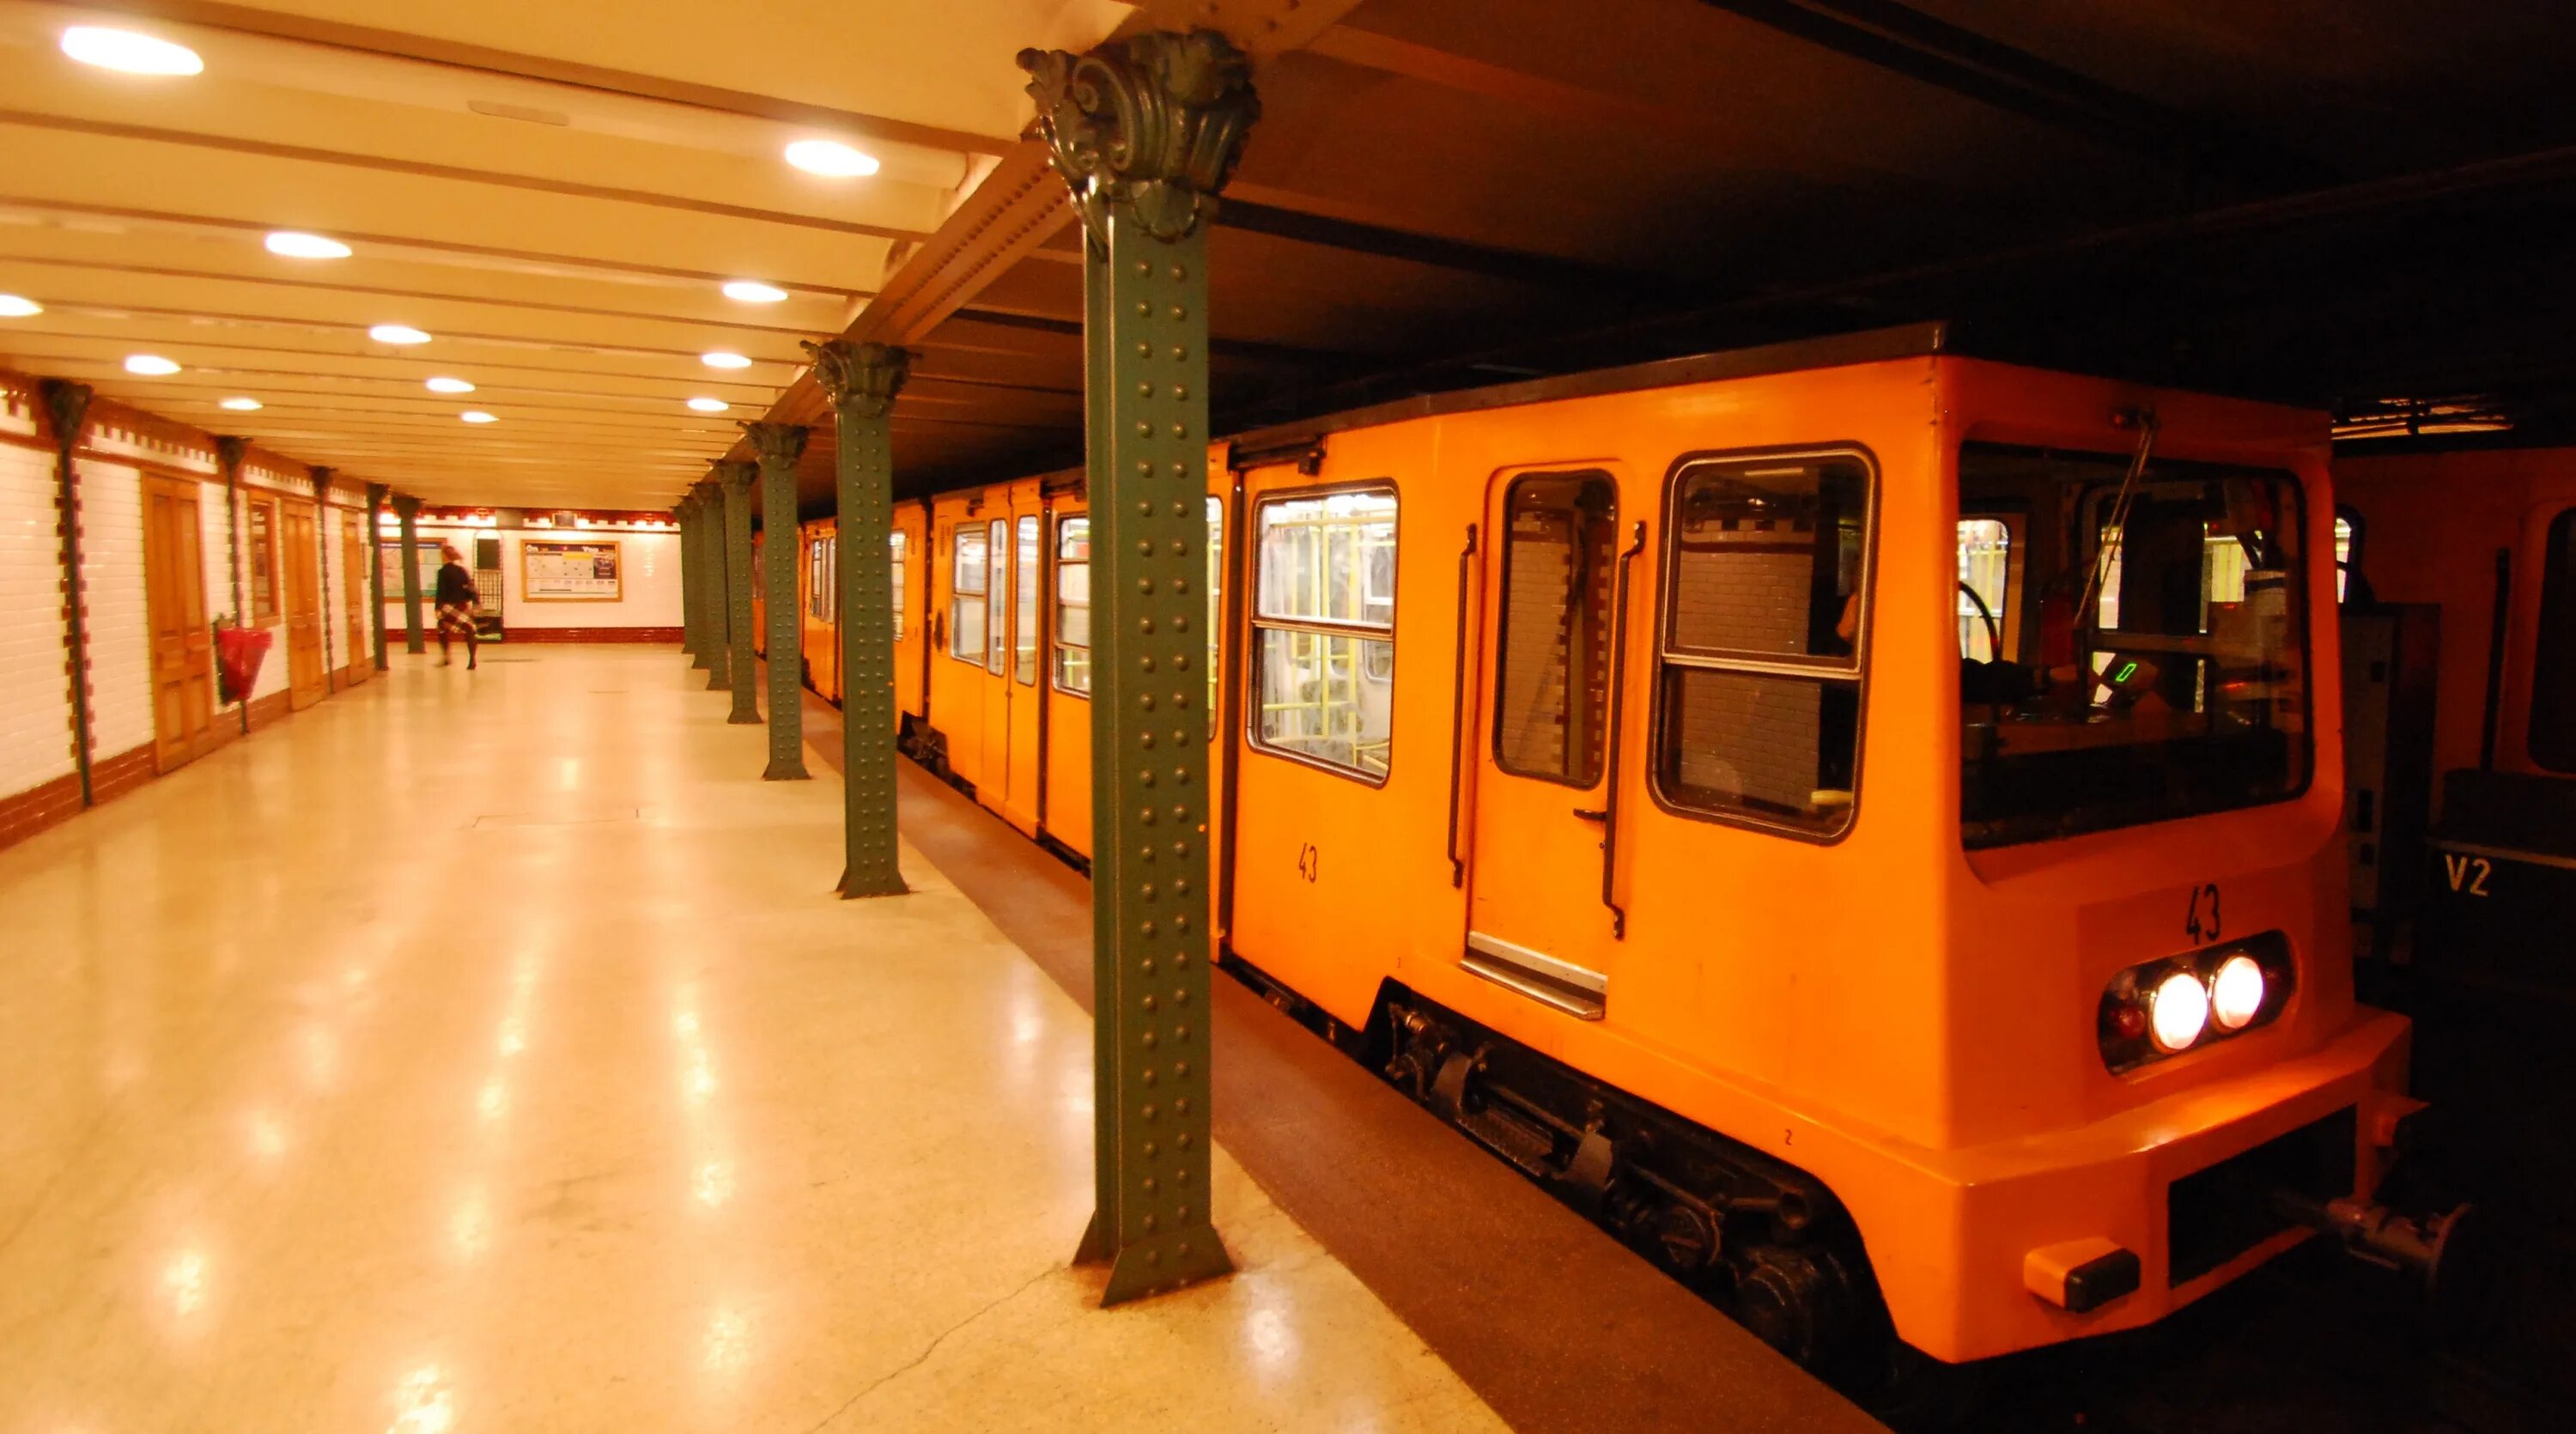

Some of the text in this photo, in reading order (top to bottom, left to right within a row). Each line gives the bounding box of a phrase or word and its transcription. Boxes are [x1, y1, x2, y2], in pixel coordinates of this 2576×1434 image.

[1299, 842, 1317, 884] 43
[2445, 854, 2492, 897] V2
[2185, 884, 2221, 945] 43
[1785, 1129, 1793, 1146] 2
